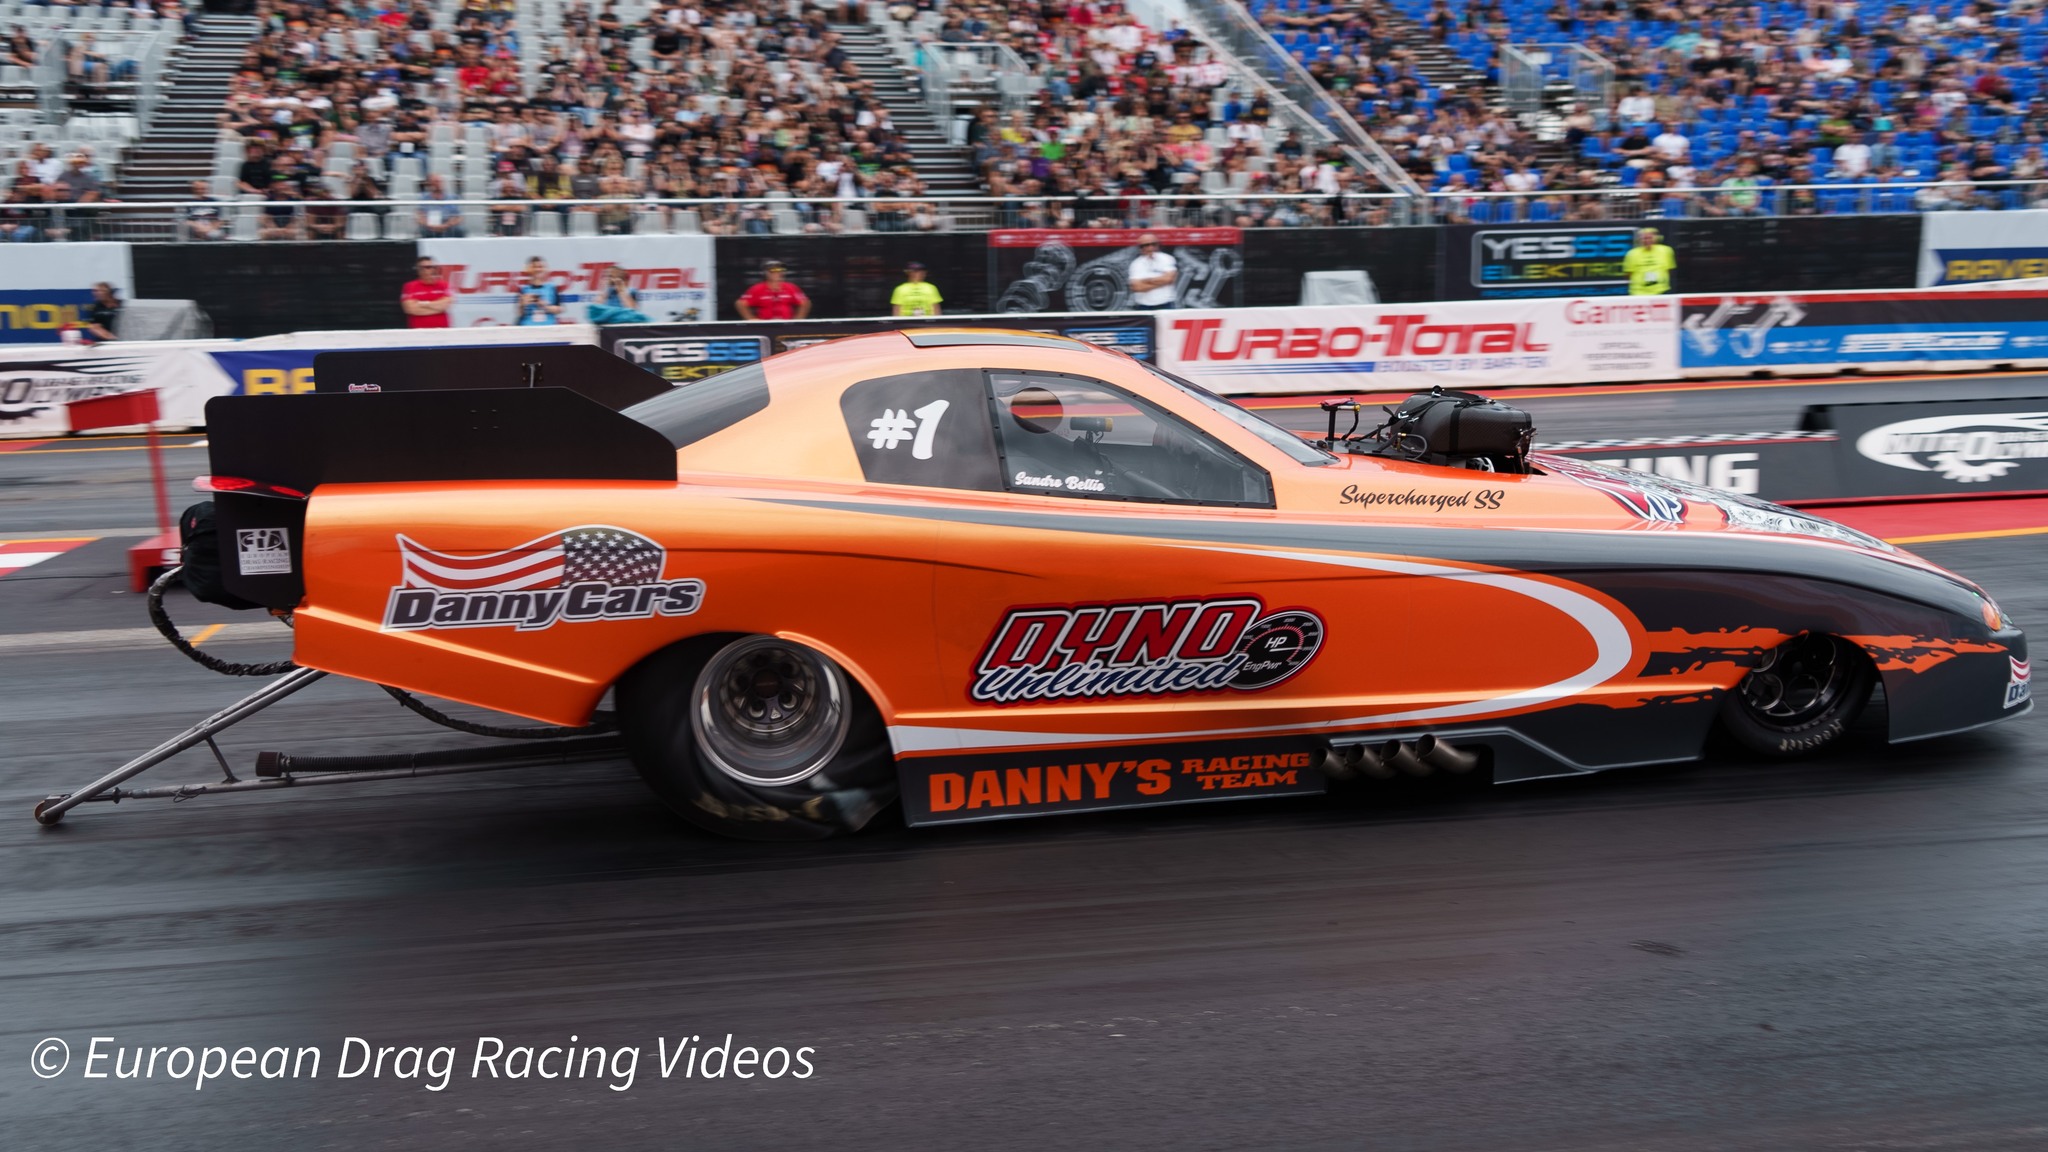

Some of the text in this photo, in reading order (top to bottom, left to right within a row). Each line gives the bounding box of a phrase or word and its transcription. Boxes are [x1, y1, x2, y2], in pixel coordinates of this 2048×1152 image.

[1481, 234, 1633, 260] YESSS
[624, 341, 762, 363] YESSS
[866, 399, 950, 460] #1
[1340, 484, 1505, 512] Supercharged SS
[388, 580, 704, 630] DannyCars
[978, 600, 1262, 673] DYNO
[1264, 636, 1288, 649] HP
[971, 655, 1250, 702] Unlimited
[1242, 660, 1283, 673] EngPwr
[1181, 752, 1311, 774] RACING
[929, 758, 1172, 812] DANNY'S
[1196, 769, 1299, 791] TEAM
